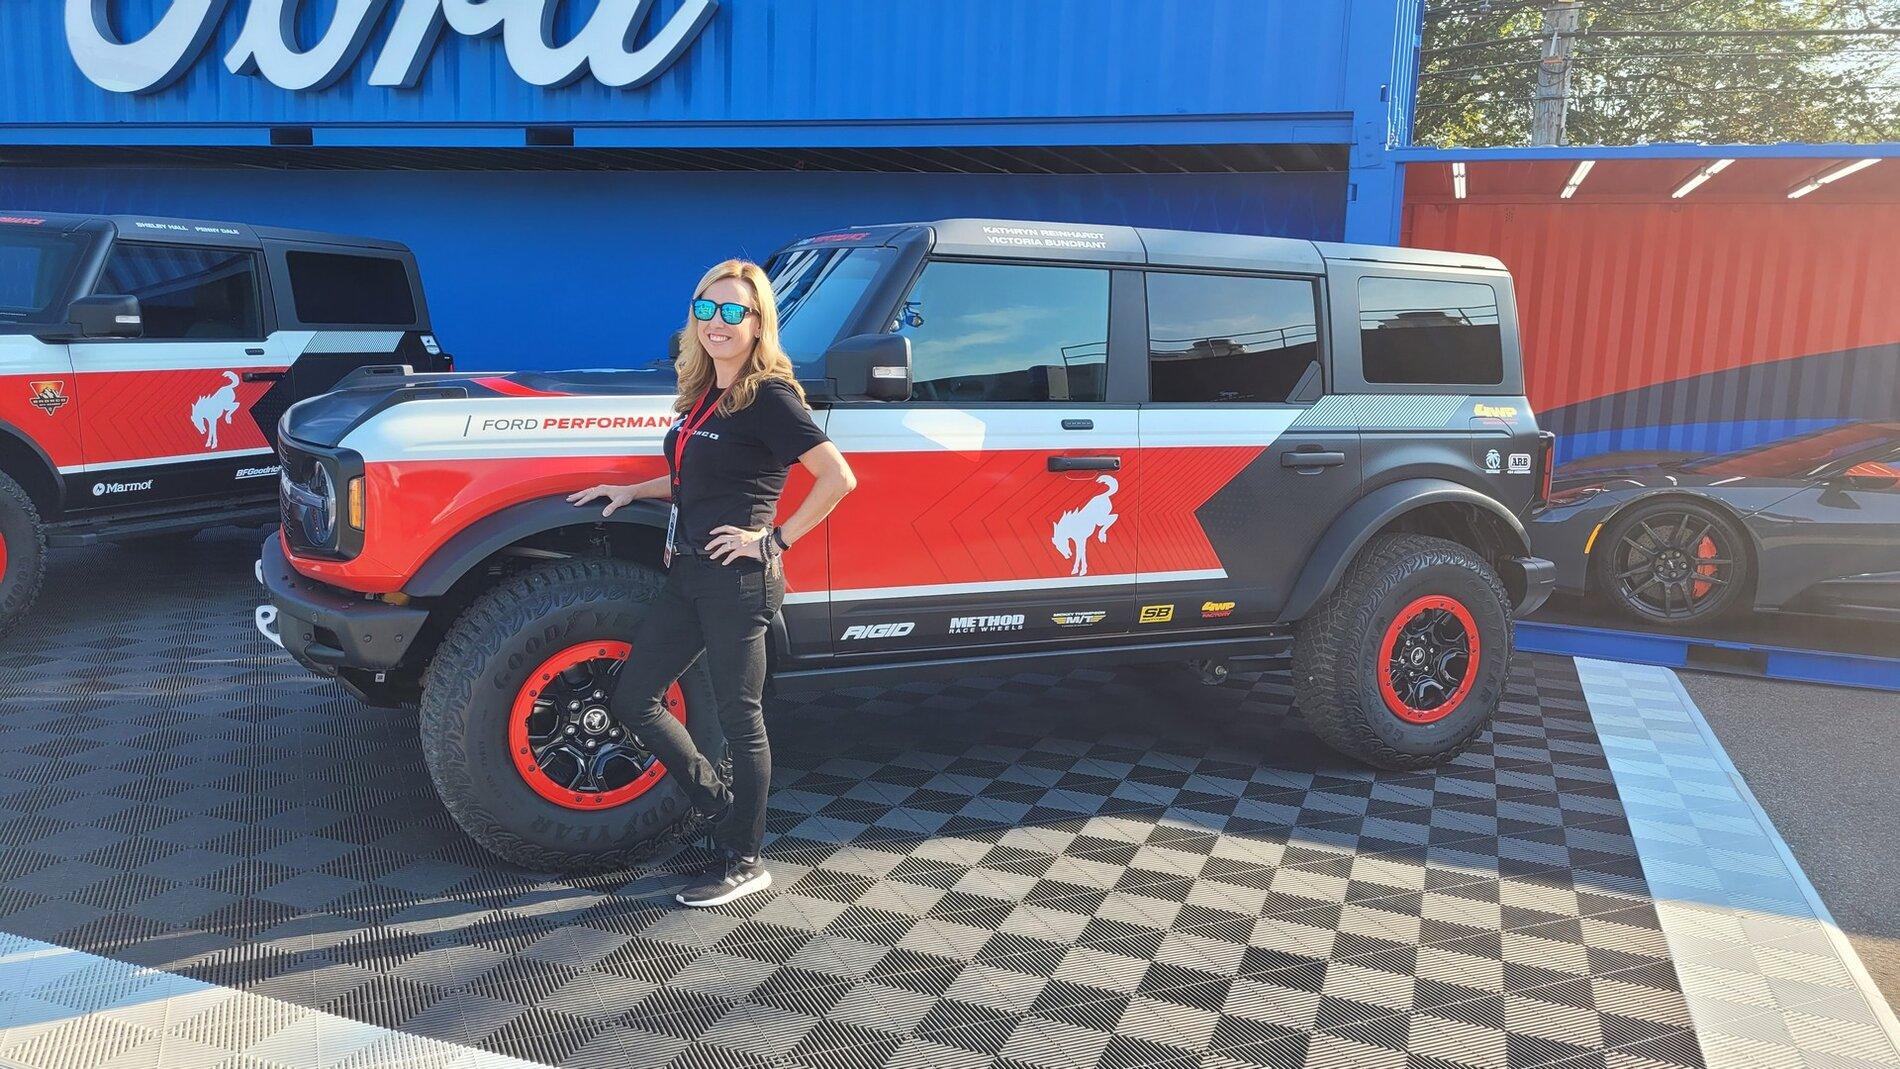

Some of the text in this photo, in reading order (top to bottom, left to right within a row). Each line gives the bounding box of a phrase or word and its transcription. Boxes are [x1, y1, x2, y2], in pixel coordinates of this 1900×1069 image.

[982, 226, 1105, 240] KATHRYN REINHARDT
[986, 236, 1107, 249] VICTORIA BUNDRANT
[482, 416, 678, 431] FORD PERFORMAN
[1511, 457, 1528, 467] ARB
[105, 479, 154, 494] Marmot
[1142, 607, 1172, 618] SB
[949, 614, 1025, 629] METHOD
[840, 622, 916, 641] RIGID
